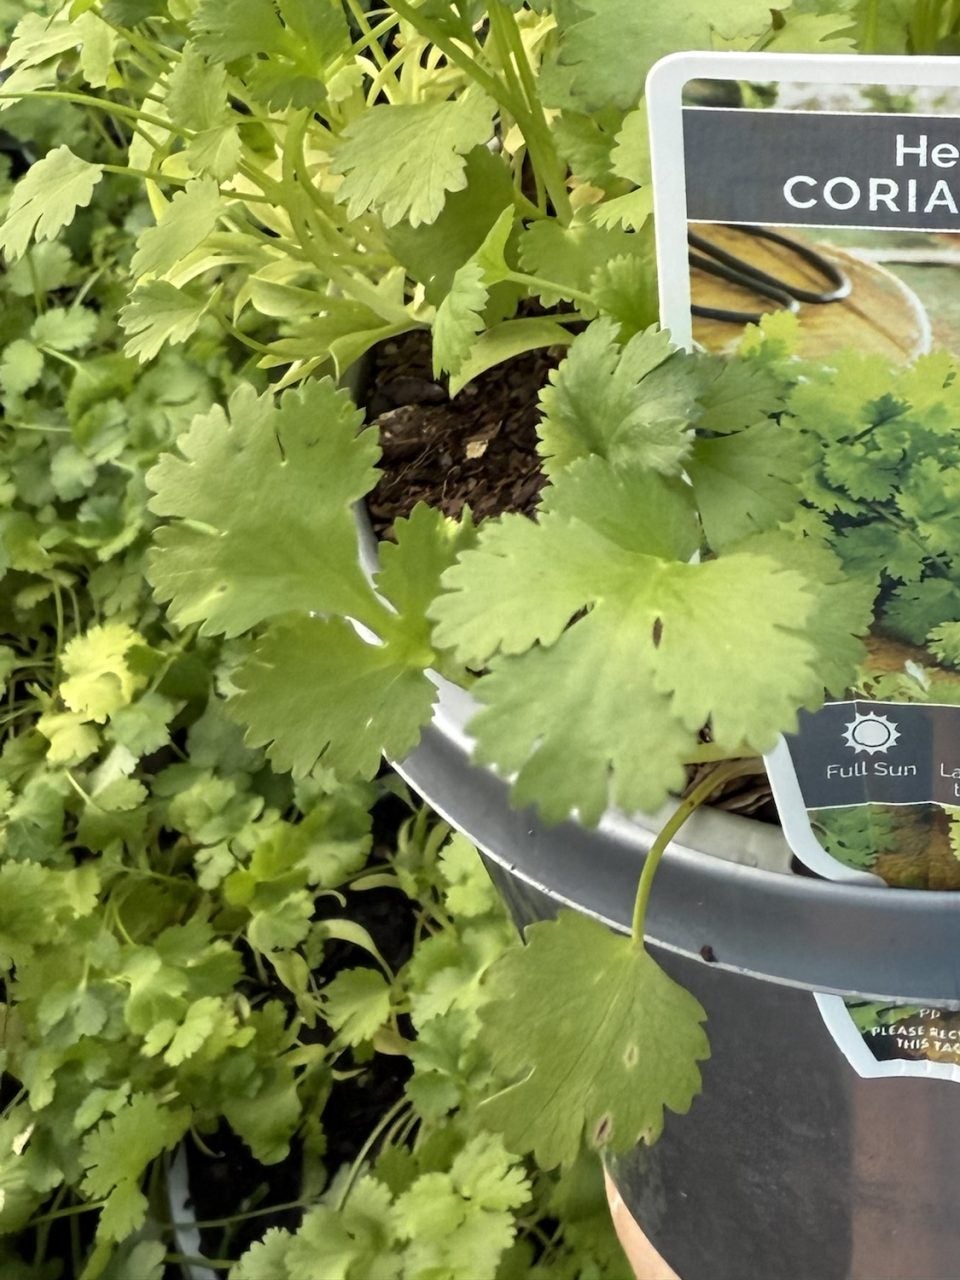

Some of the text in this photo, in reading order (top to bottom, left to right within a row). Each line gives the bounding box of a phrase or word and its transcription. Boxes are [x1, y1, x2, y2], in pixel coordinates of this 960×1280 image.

[827, 761, 917, 779] Full Sun
[871, 1025, 925, 1037] PLEASE
[897, 1038, 930, 1050] THIS
